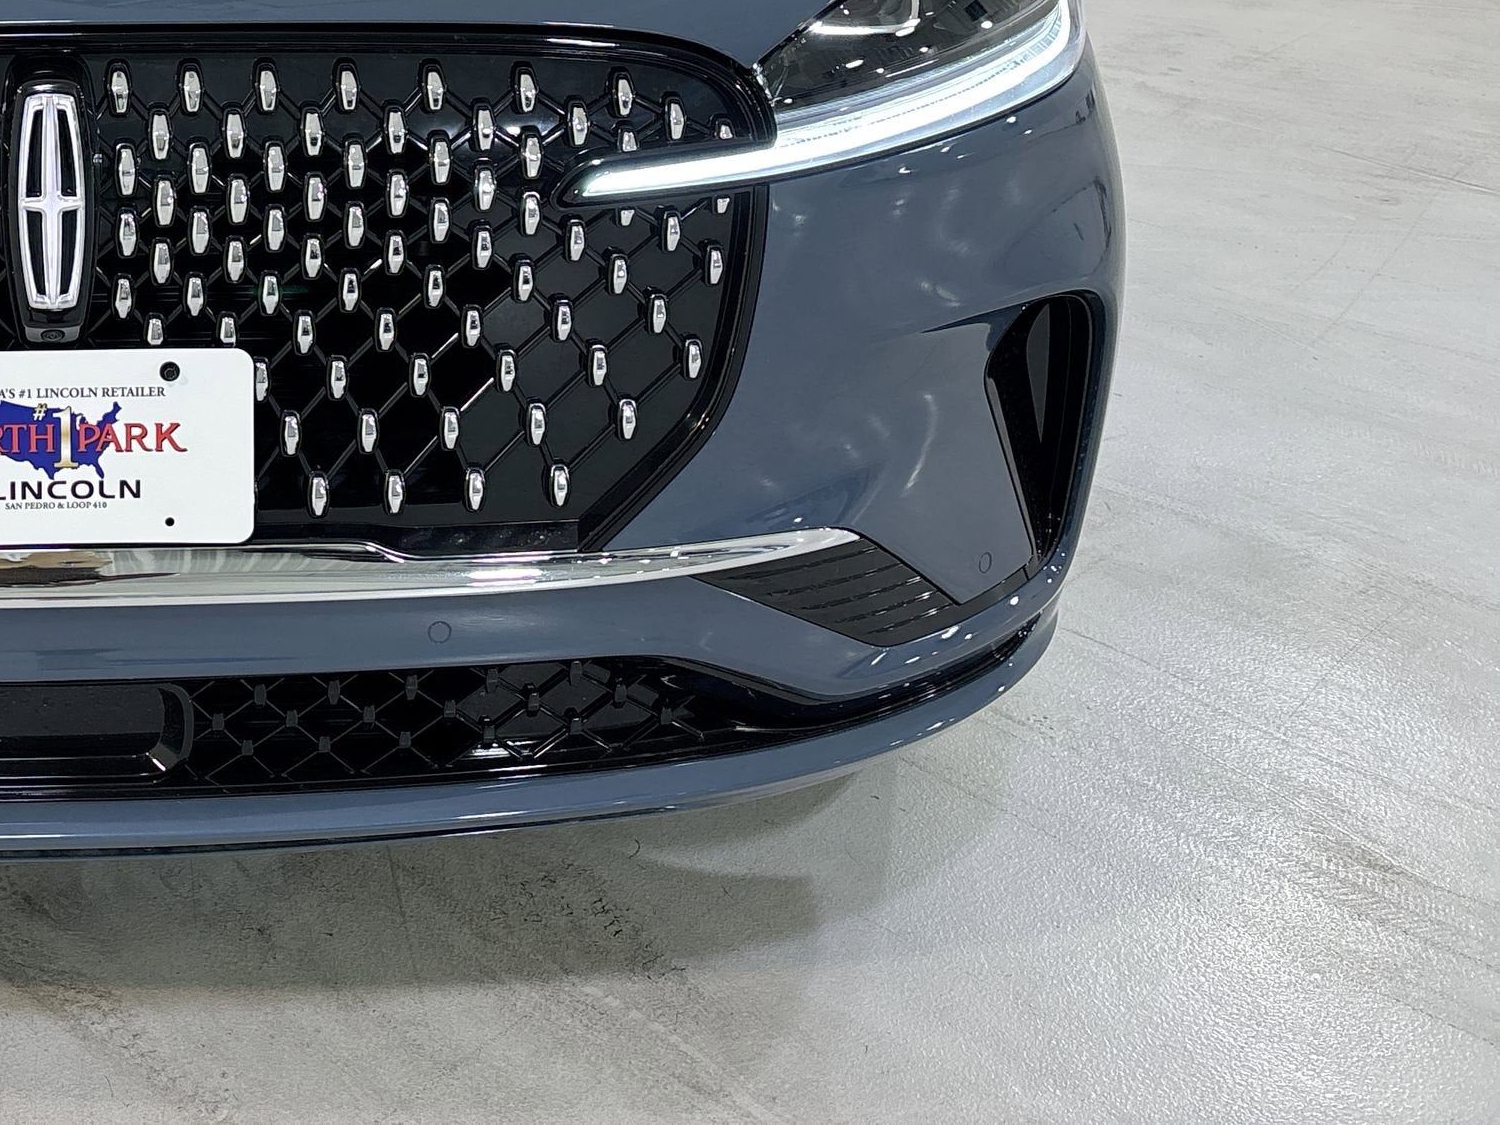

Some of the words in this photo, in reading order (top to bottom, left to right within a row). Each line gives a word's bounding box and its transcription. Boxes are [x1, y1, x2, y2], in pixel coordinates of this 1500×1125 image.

[18, 389, 33, 399] #1
[36, 387, 98, 399] LINCOLN
[101, 386, 167, 398] RETAILER
[77, 422, 189, 453] PARK
[5, 502, 23, 510] SAN
[25, 502, 56, 510] PEDRO
[66, 501, 92, 509] LOOP
[93, 501, 108, 509] 410
